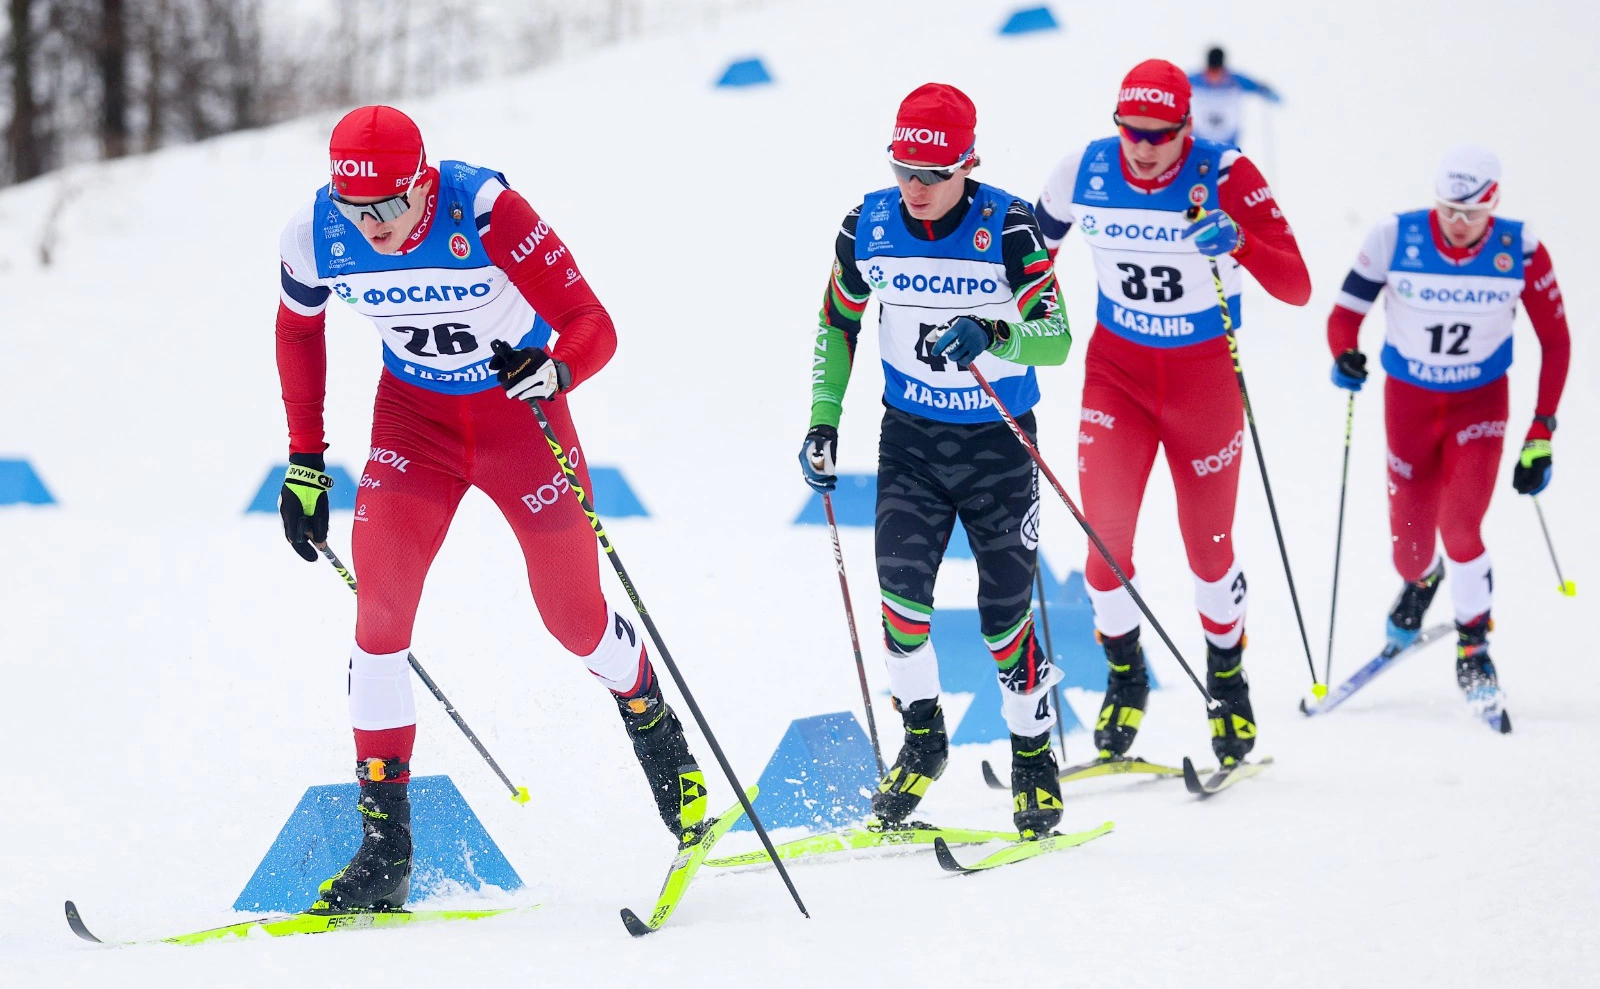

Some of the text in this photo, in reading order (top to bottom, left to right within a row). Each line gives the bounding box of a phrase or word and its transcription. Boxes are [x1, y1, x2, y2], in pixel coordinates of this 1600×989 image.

[1119, 87, 1176, 108] LUKOIL
[892, 127, 949, 147] LUKOIL
[330, 159, 378, 177] KOIL
[511, 219, 551, 263] LUKO
[1105, 223, 1184, 242] ФОСАГ
[363, 281, 491, 306] ФОСАГРО
[892, 273, 998, 295] ФОСАГРО
[1116, 262, 1184, 303] 33
[1419, 289, 1510, 305] ФОСАГРО
[1113, 305, 1195, 337] КАЗАНЬ
[391, 322, 479, 358] 26
[914, 322, 969, 372] 4
[1425, 322, 1472, 356] 12
[812, 326, 829, 384] AZAN
[1408, 360, 1481, 384] КАЗАНЬ
[370, 447, 410, 473] KOIL
[1191, 430, 1244, 477] BOSCO
[521, 446, 580, 514] BOSO
[614, 611, 636, 648] 2
[357, 804, 388, 820] SCHER
